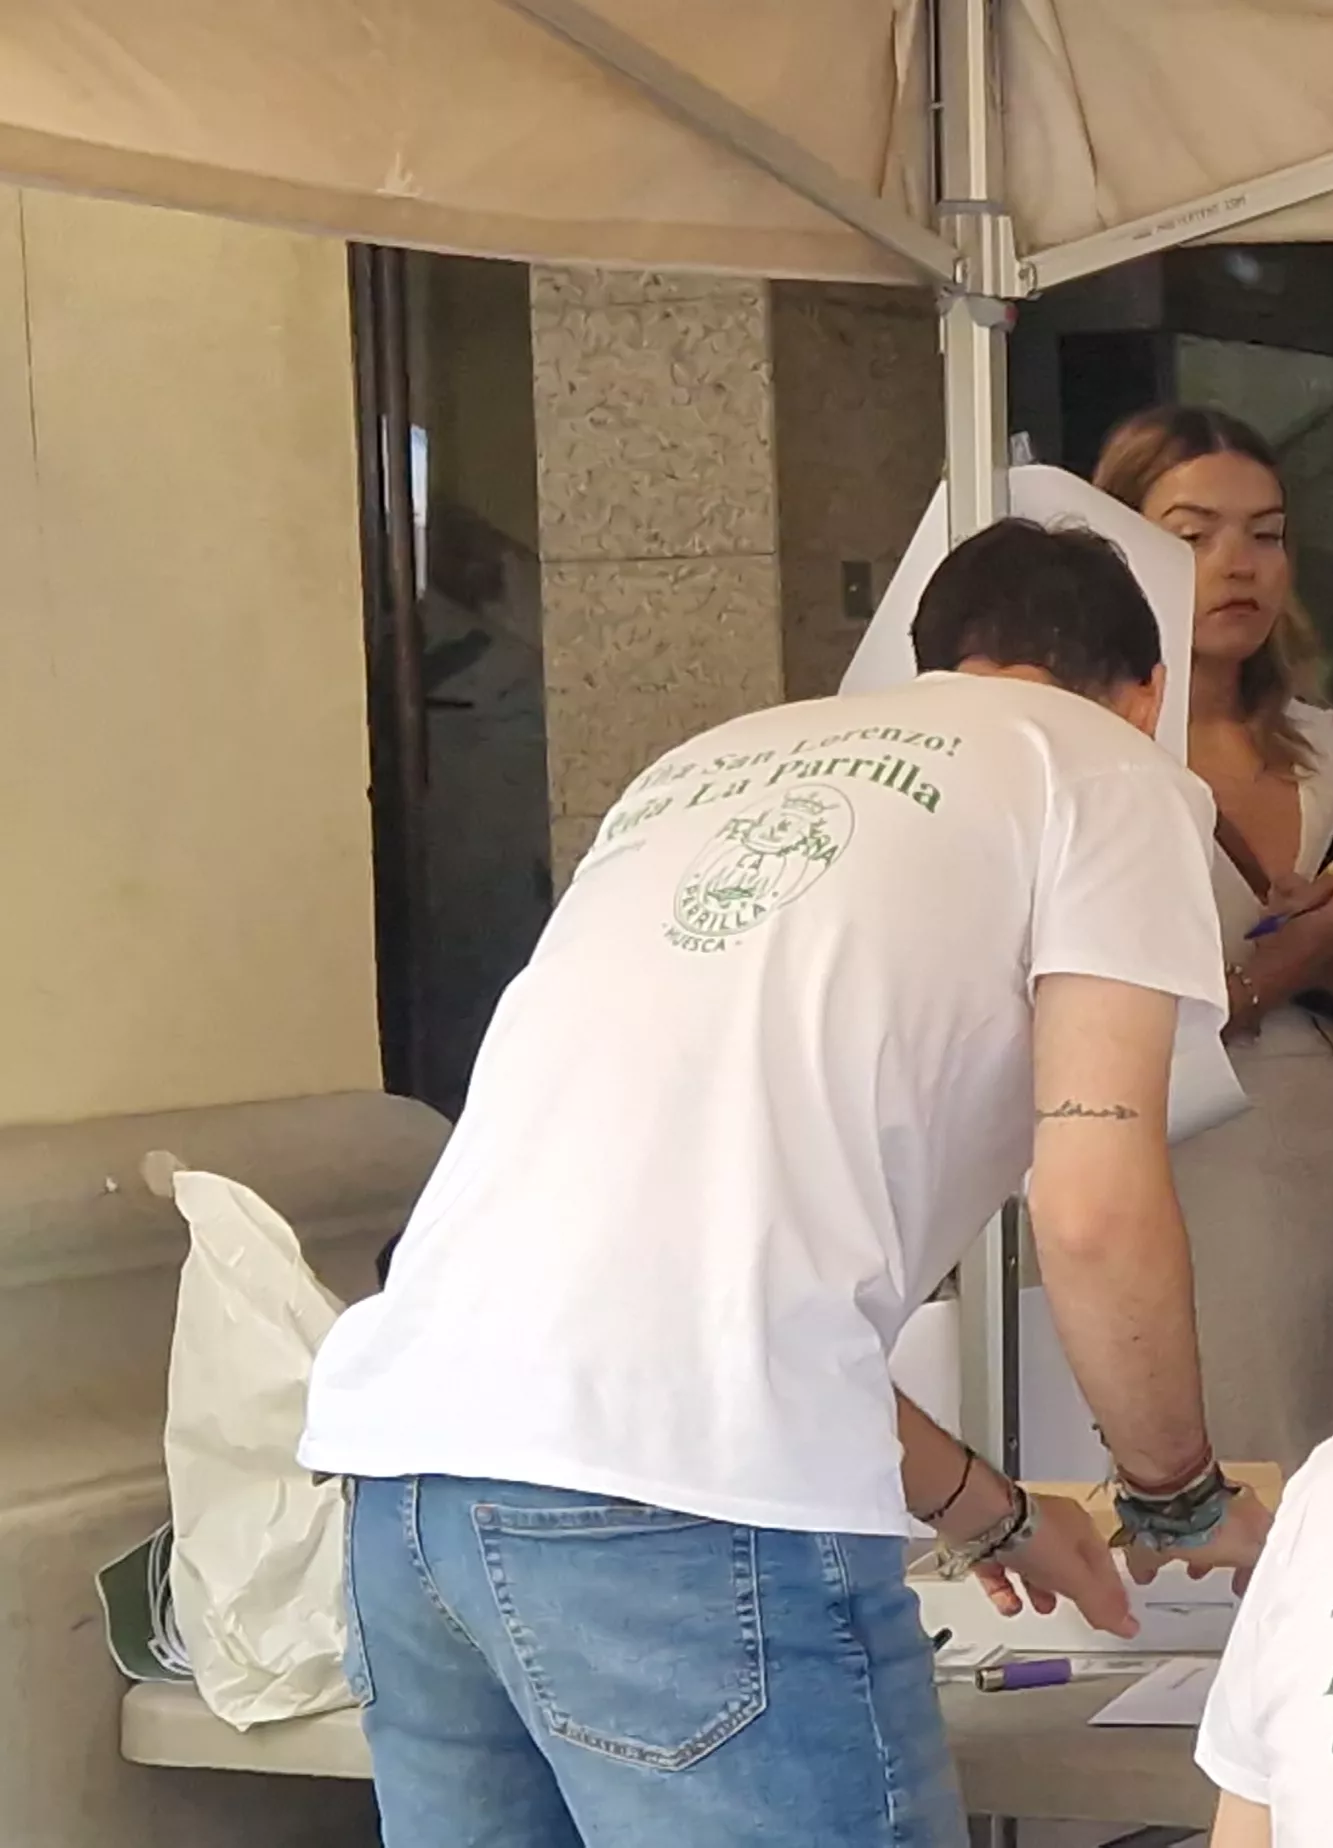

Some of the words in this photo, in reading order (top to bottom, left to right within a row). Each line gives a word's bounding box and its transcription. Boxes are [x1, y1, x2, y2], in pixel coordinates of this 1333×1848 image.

[702, 750, 776, 775] San
[791, 726, 963, 757] Lorenzo!
[685, 778, 750, 808] La
[766, 755, 942, 814] Parrilla
[663, 926, 727, 953] HUESCA
